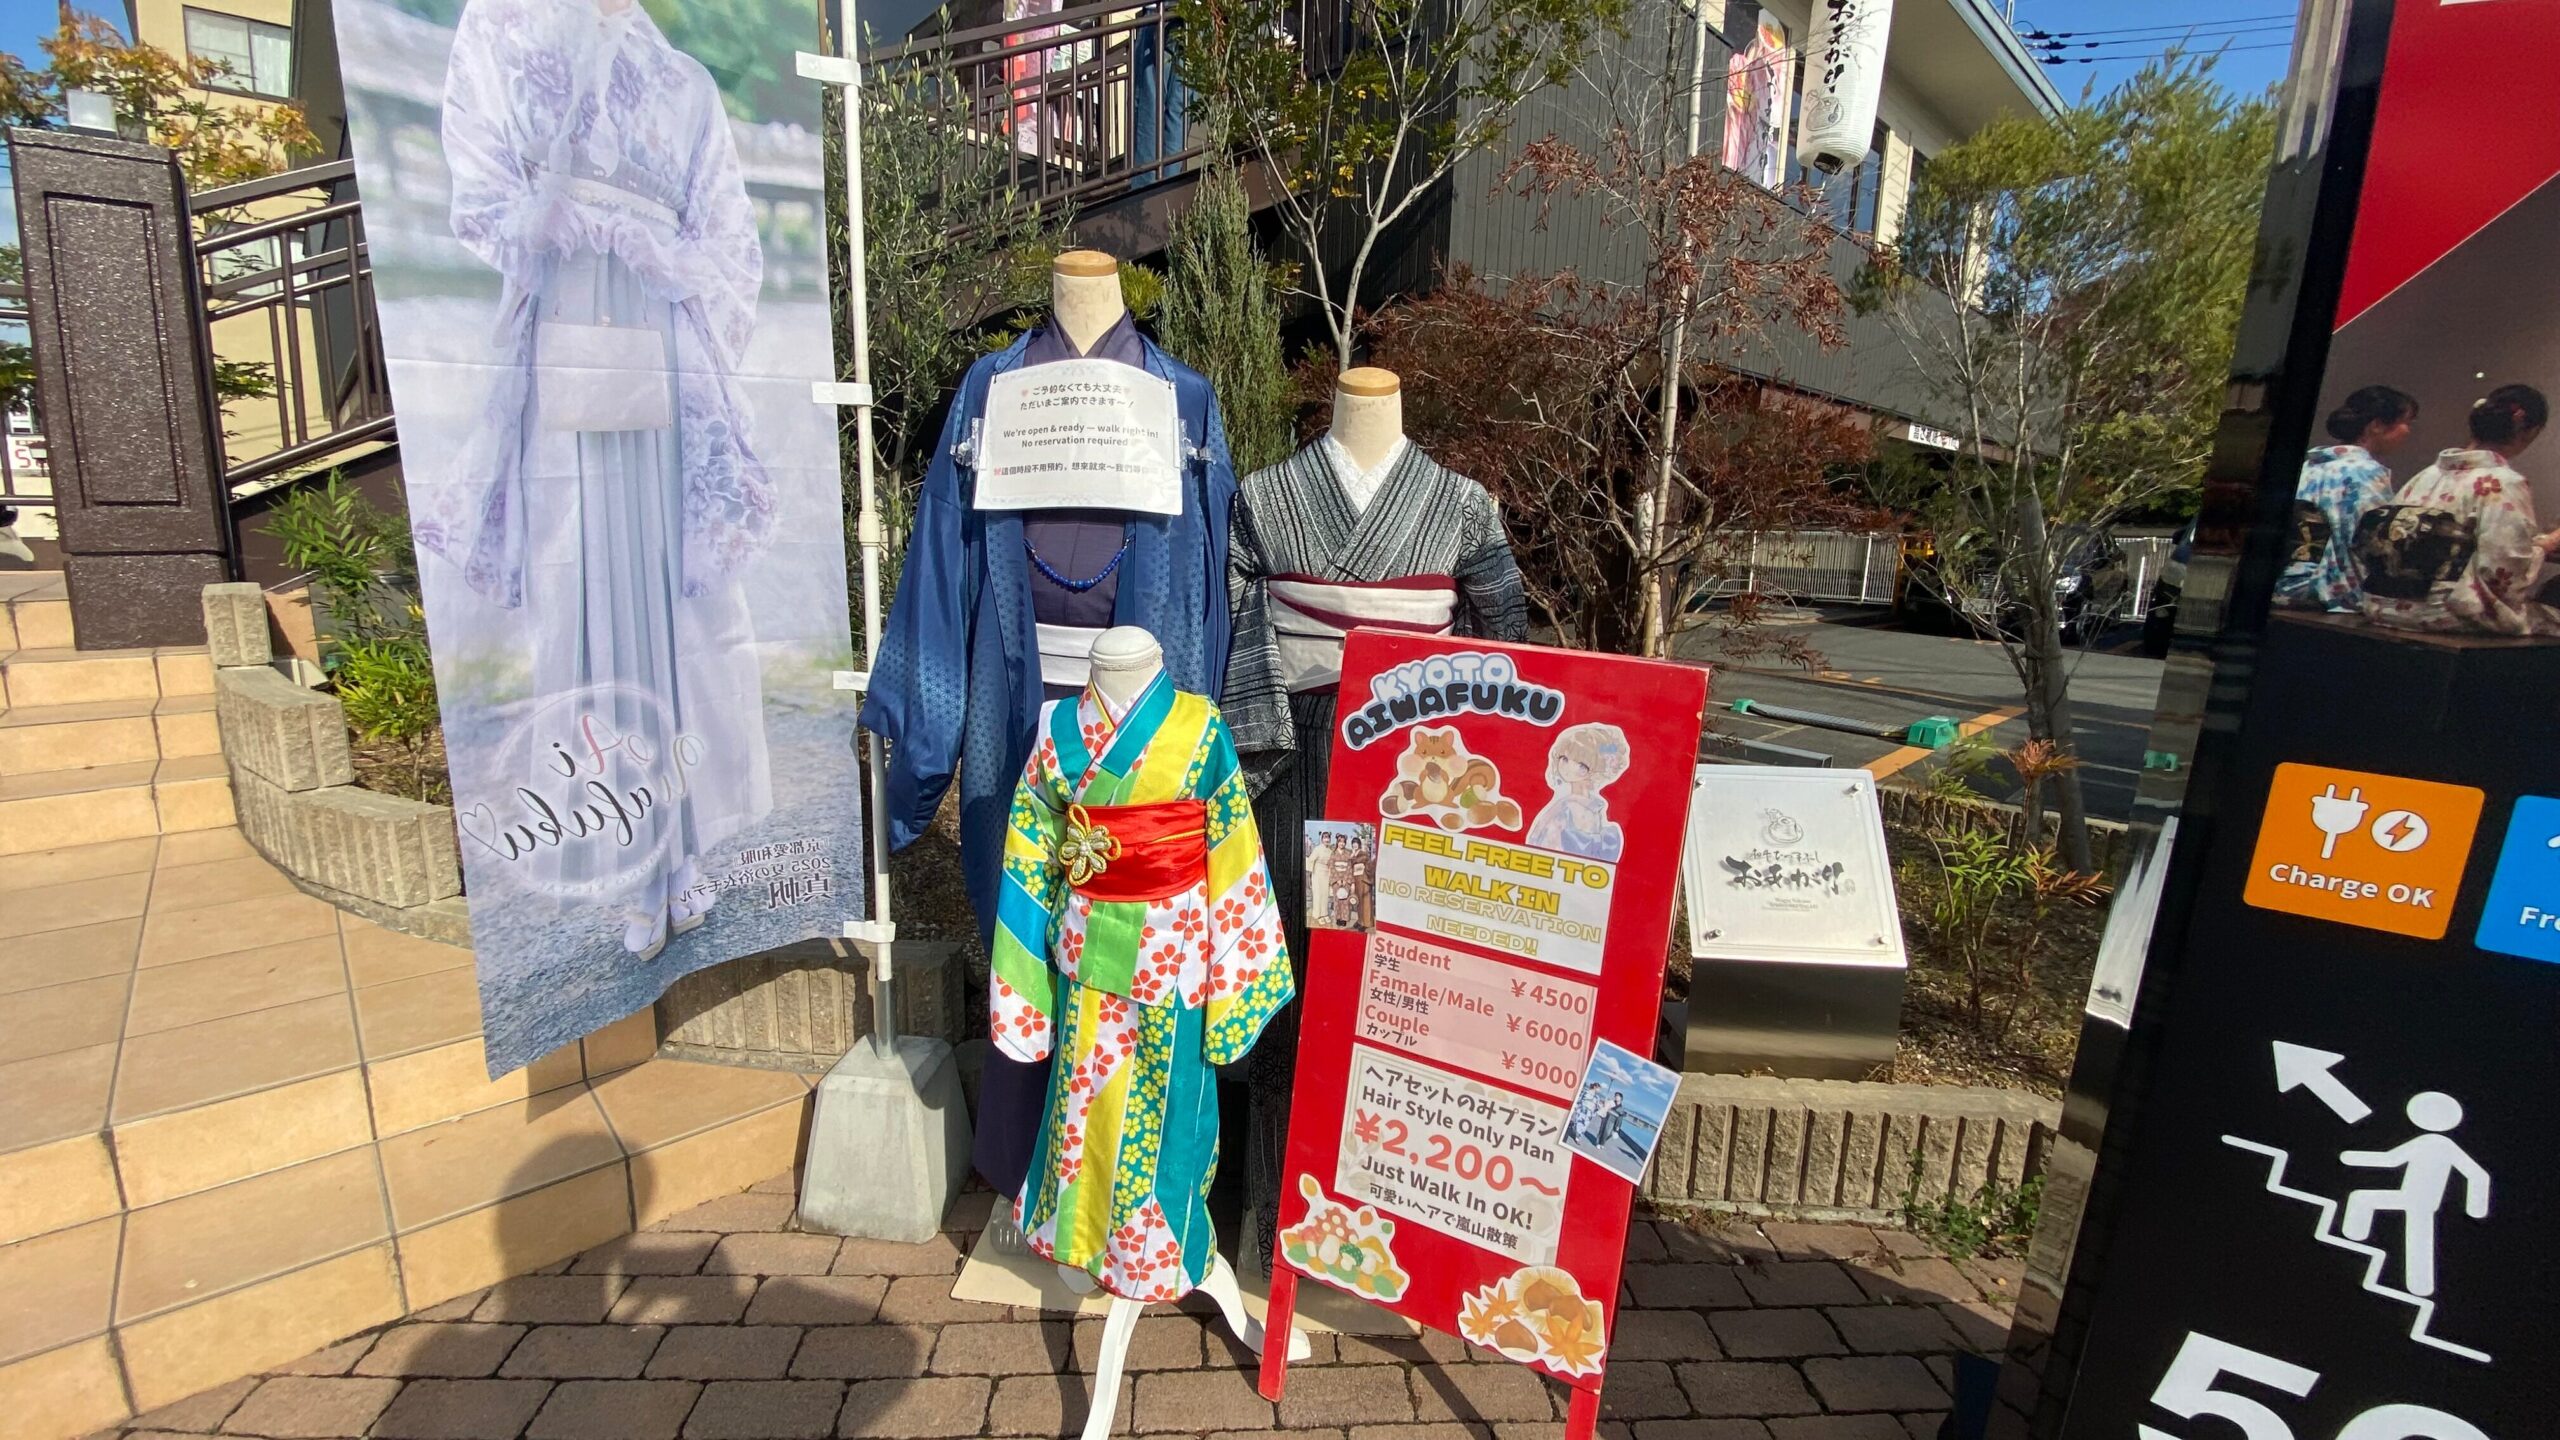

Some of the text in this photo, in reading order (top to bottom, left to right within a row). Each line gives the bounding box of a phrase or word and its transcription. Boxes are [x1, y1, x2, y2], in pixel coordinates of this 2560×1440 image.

[1003, 428, 1027, 438] We're
[1027, 426, 1049, 436] open
[1050, 425, 1057, 433] &
[1058, 423, 1085, 434] ready
[1097, 424, 1120, 433] walk
[1021, 435, 1129, 448] No reservation required
[1372, 655, 1513, 702] KYOTO
[1345, 682, 1563, 749] AIWAFUKU
[1382, 825, 1610, 890] FEEL FREE TO
[1423, 864, 1561, 917] WALK IN
[2269, 862, 2436, 909] Charge OK
[1378, 877, 1602, 945] NO RESERVATION
[1373, 936, 1452, 971] Student
[1426, 914, 1540, 958] NEEDED!!
[1373, 953, 1401, 972] 学生
[1368, 970, 1495, 1018] Famale/Male
[1369, 986, 1430, 1016] 女性/男性
[1510, 978, 1589, 1016] ¥4500
[1364, 1004, 1431, 1039] Couple
[1365, 1021, 1418, 1048] カップル
[1506, 1013, 1583, 1051] ¥6000
[1501, 1050, 1578, 1090] ¥9000
[1365, 1065, 1558, 1137] ヘアセットのみプラン
[1362, 1085, 1556, 1164] Hair Style Only Plan
[1361, 1155, 1534, 1231] Just Walk In OK!
[1368, 1182, 1519, 1251] 可愛いヘアで嵐山散策
